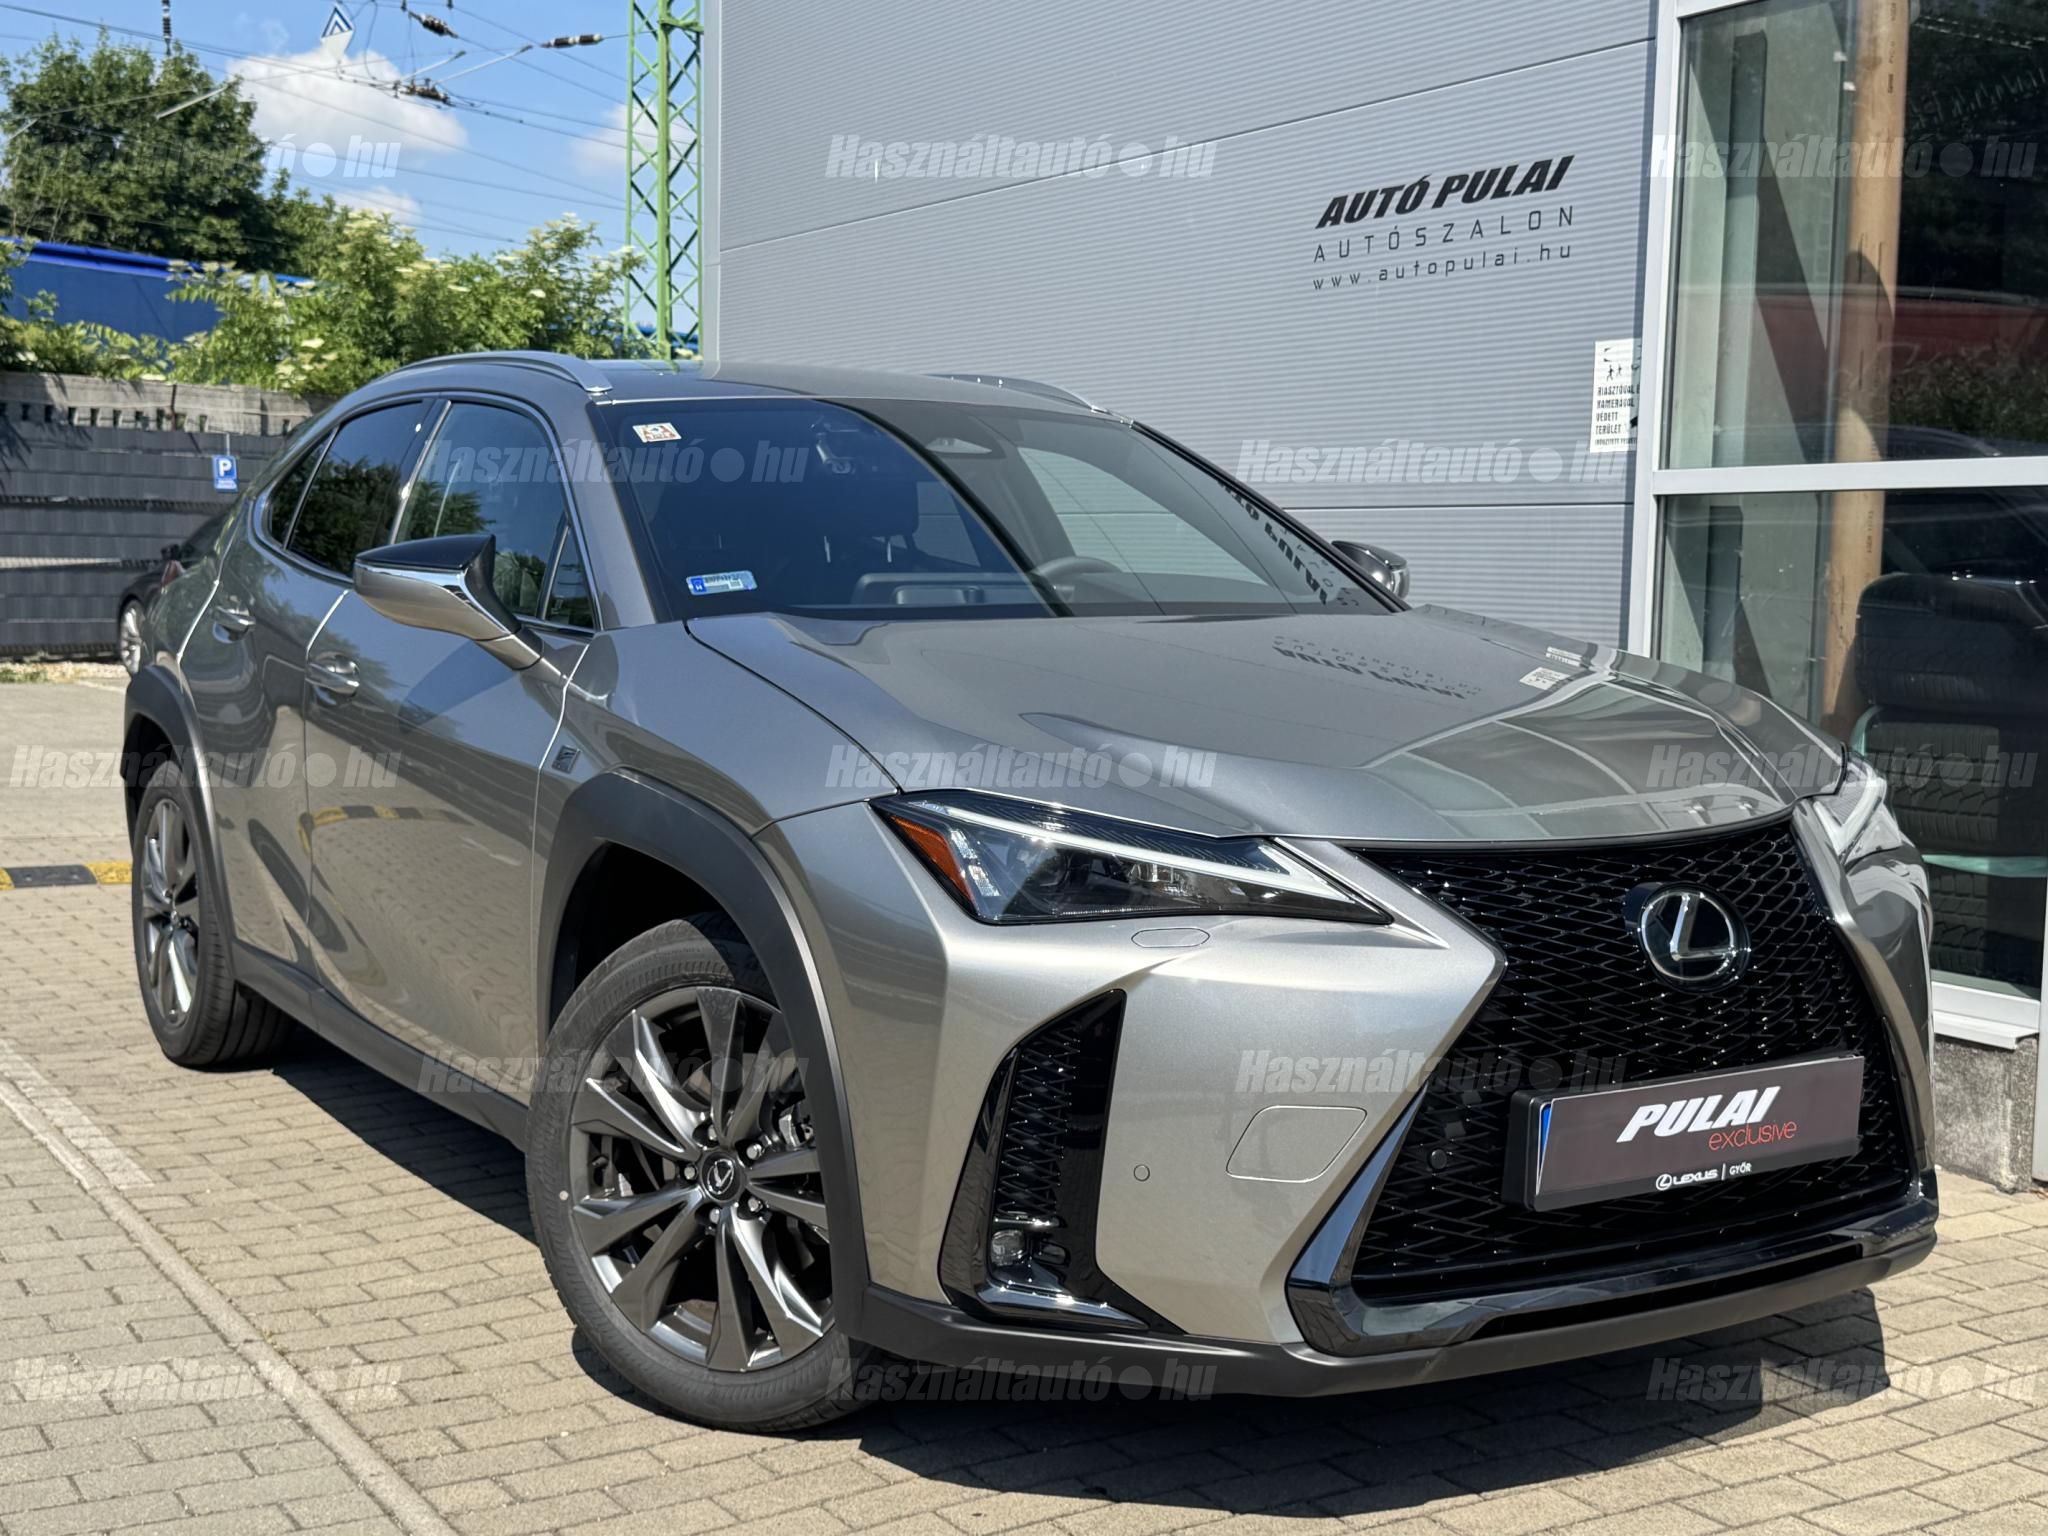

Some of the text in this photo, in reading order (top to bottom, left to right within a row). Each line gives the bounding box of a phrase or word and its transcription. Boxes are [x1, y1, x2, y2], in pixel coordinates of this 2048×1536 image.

[1315, 155, 1575, 229] AUTÓ PULAI
[1314, 205, 1573, 263] AUTÓSZALON
[1313, 243, 1571, 290] www.autopulai.hu
[218, 459, 232, 477] P
[1616, 1086, 1781, 1143] PULAI
[1708, 1120, 1798, 1151] exclusive
[1673, 1169, 1719, 1185] LEXUS
